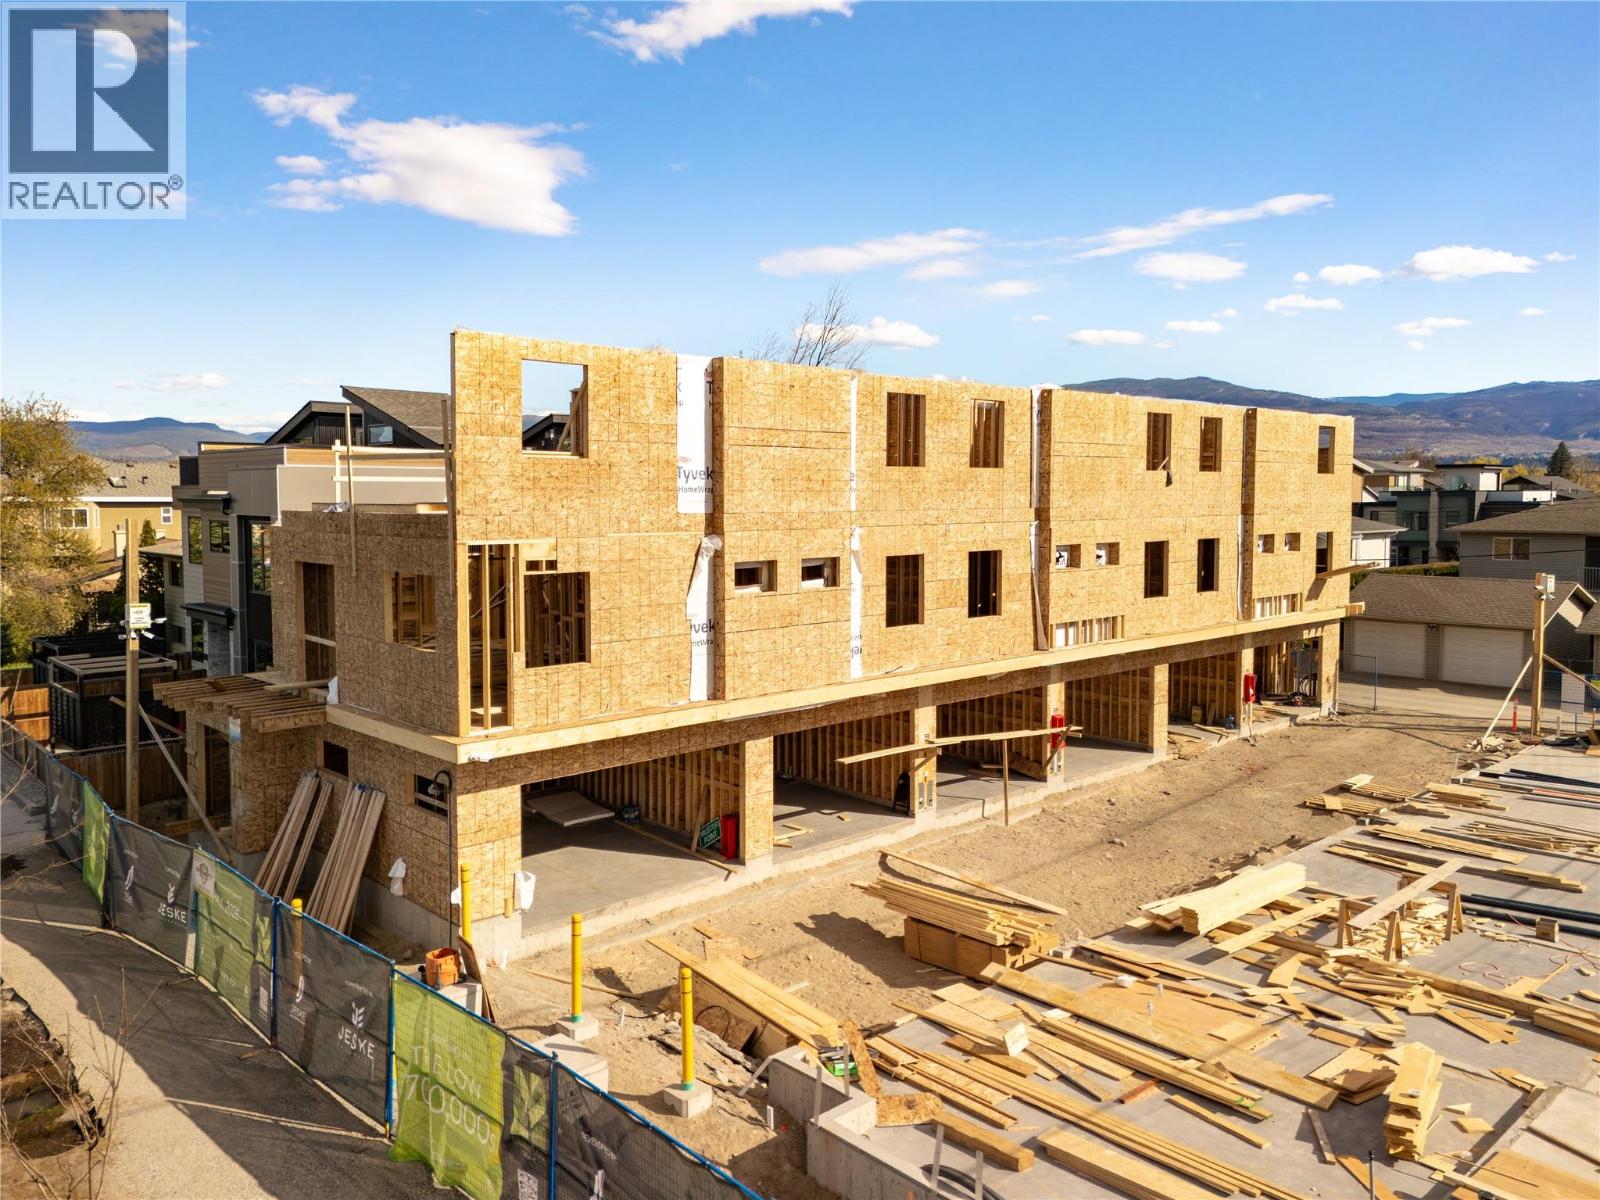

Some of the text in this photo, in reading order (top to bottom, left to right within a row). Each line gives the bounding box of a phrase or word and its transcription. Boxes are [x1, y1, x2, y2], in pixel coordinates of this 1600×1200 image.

[677, 465, 714, 484] Tyvek
[157, 902, 187, 924] JESKE
[338, 1025, 375, 1060] JESKE
